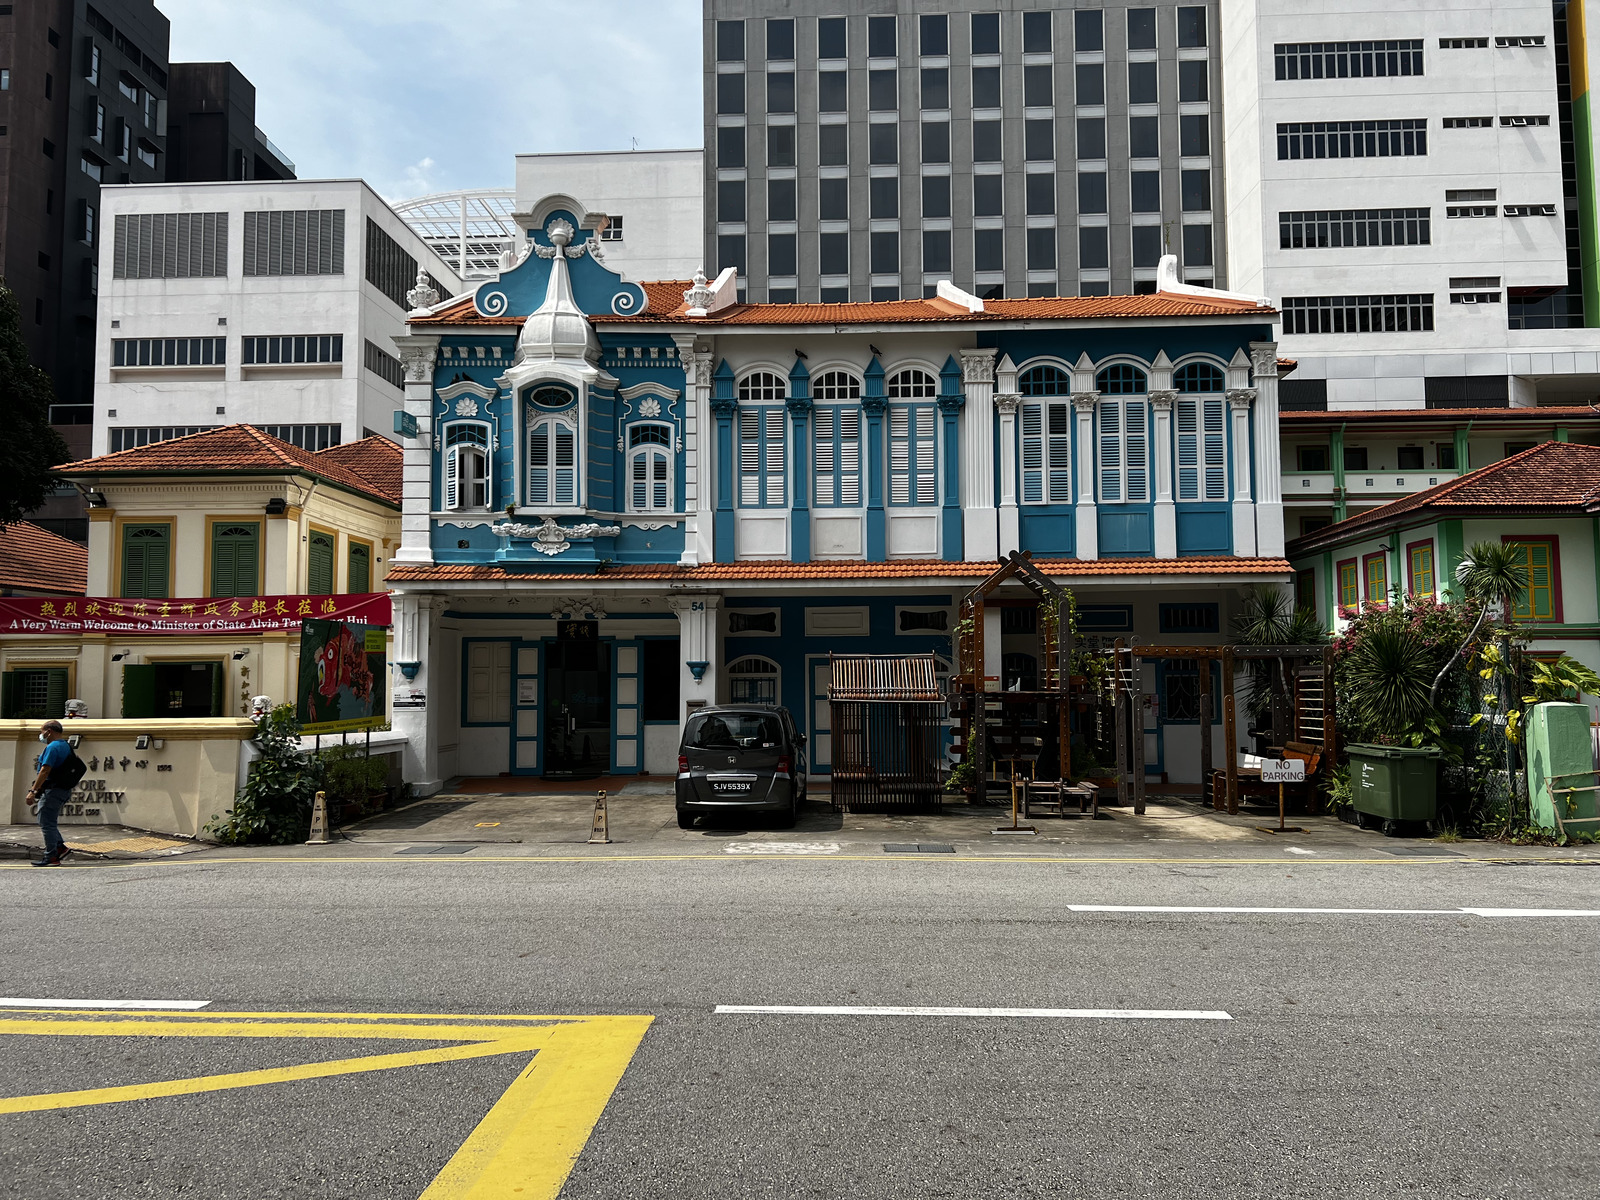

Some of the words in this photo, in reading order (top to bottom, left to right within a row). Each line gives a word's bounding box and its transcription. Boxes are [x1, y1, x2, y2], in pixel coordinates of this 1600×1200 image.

[692, 601, 704, 611] 54
[10, 619, 19, 629] A
[21, 619, 48, 631] Very
[49, 619, 81, 630] Warm
[83, 619, 134, 630] Welcome
[137, 619, 149, 630] to
[151, 619, 200, 630] Minister
[202, 620, 216, 630] of
[216, 619, 246, 630] State
[250, 618, 279, 628] Alvin
[1276, 761, 1290, 769] NO
[1263, 772, 1304, 780] PARKING
